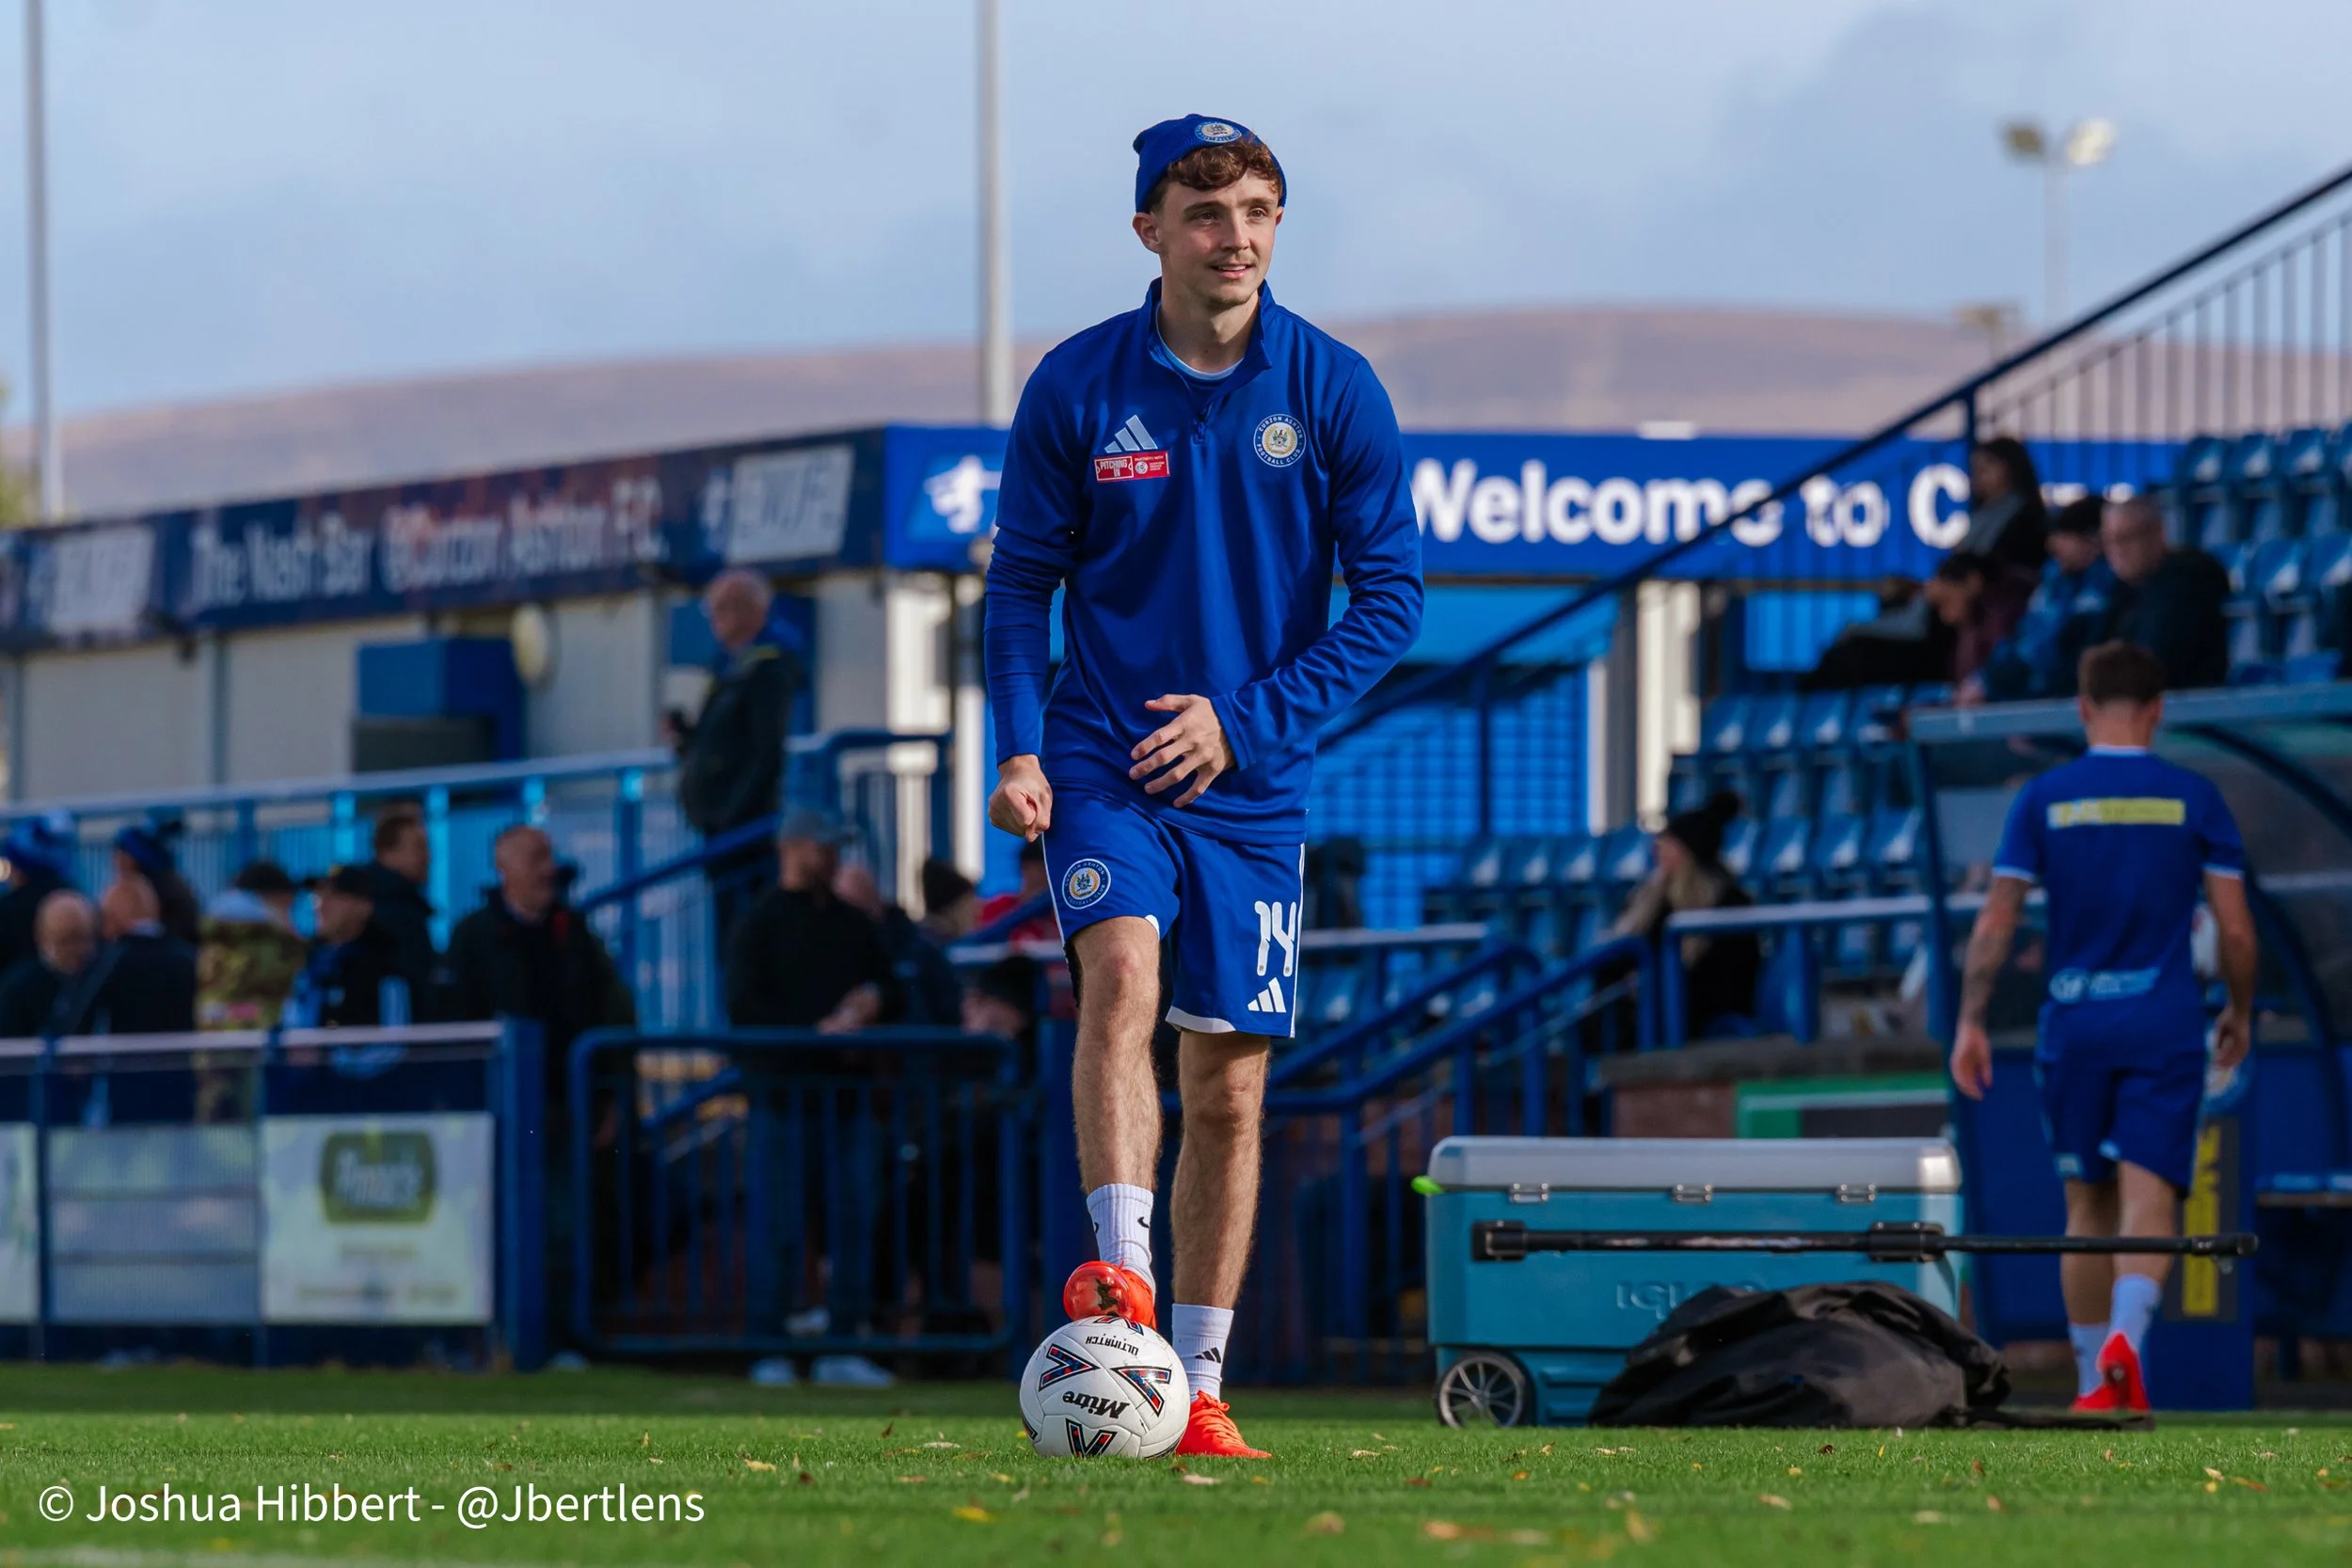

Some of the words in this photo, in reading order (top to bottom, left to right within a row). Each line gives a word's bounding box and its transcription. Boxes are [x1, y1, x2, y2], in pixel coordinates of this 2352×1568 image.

[1258, 416, 1282, 433] CURZON
[1284, 418, 1303, 438] ASHTON
[1100, 459, 1128, 470] PITCHING
[1256, 443, 1285, 465] FOOTBALL
[1285, 449, 1301, 464] CLUB
[1413, 457, 1784, 547] Welcome
[1804, 474, 1890, 548] to
[1254, 900, 1297, 977] 14
[1085, 1336, 1139, 1355] ULTIMATCH
[1062, 1390, 1130, 1419] Mitre
